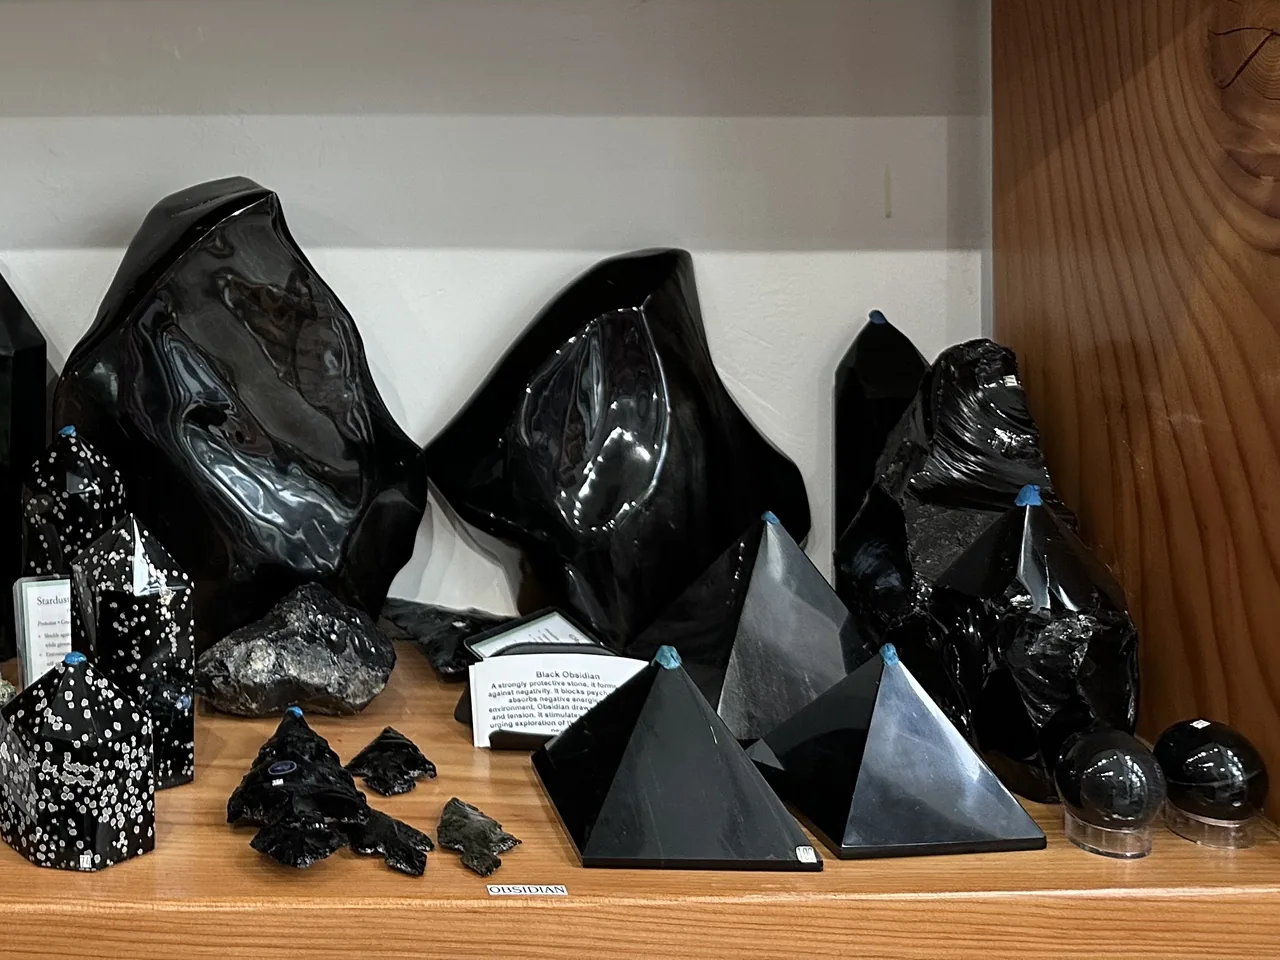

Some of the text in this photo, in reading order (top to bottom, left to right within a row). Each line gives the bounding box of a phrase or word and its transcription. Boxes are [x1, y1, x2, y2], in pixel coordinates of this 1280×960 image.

[536, 670, 601, 680] Black Obsidian
[498, 681, 527, 689] strongly
[529, 680, 565, 688] protective
[488, 688, 514, 698] against
[515, 687, 552, 696] negativity.
[560, 688, 585, 696] blocks
[539, 696, 570, 704] negative
[488, 703, 570, 713] environment. Obsidian
[506, 712, 536, 720] tension.
[489, 721, 513, 730] urging
[515, 720, 556, 729] exploration
[489, 886, 565, 894] OBSIDIAN
